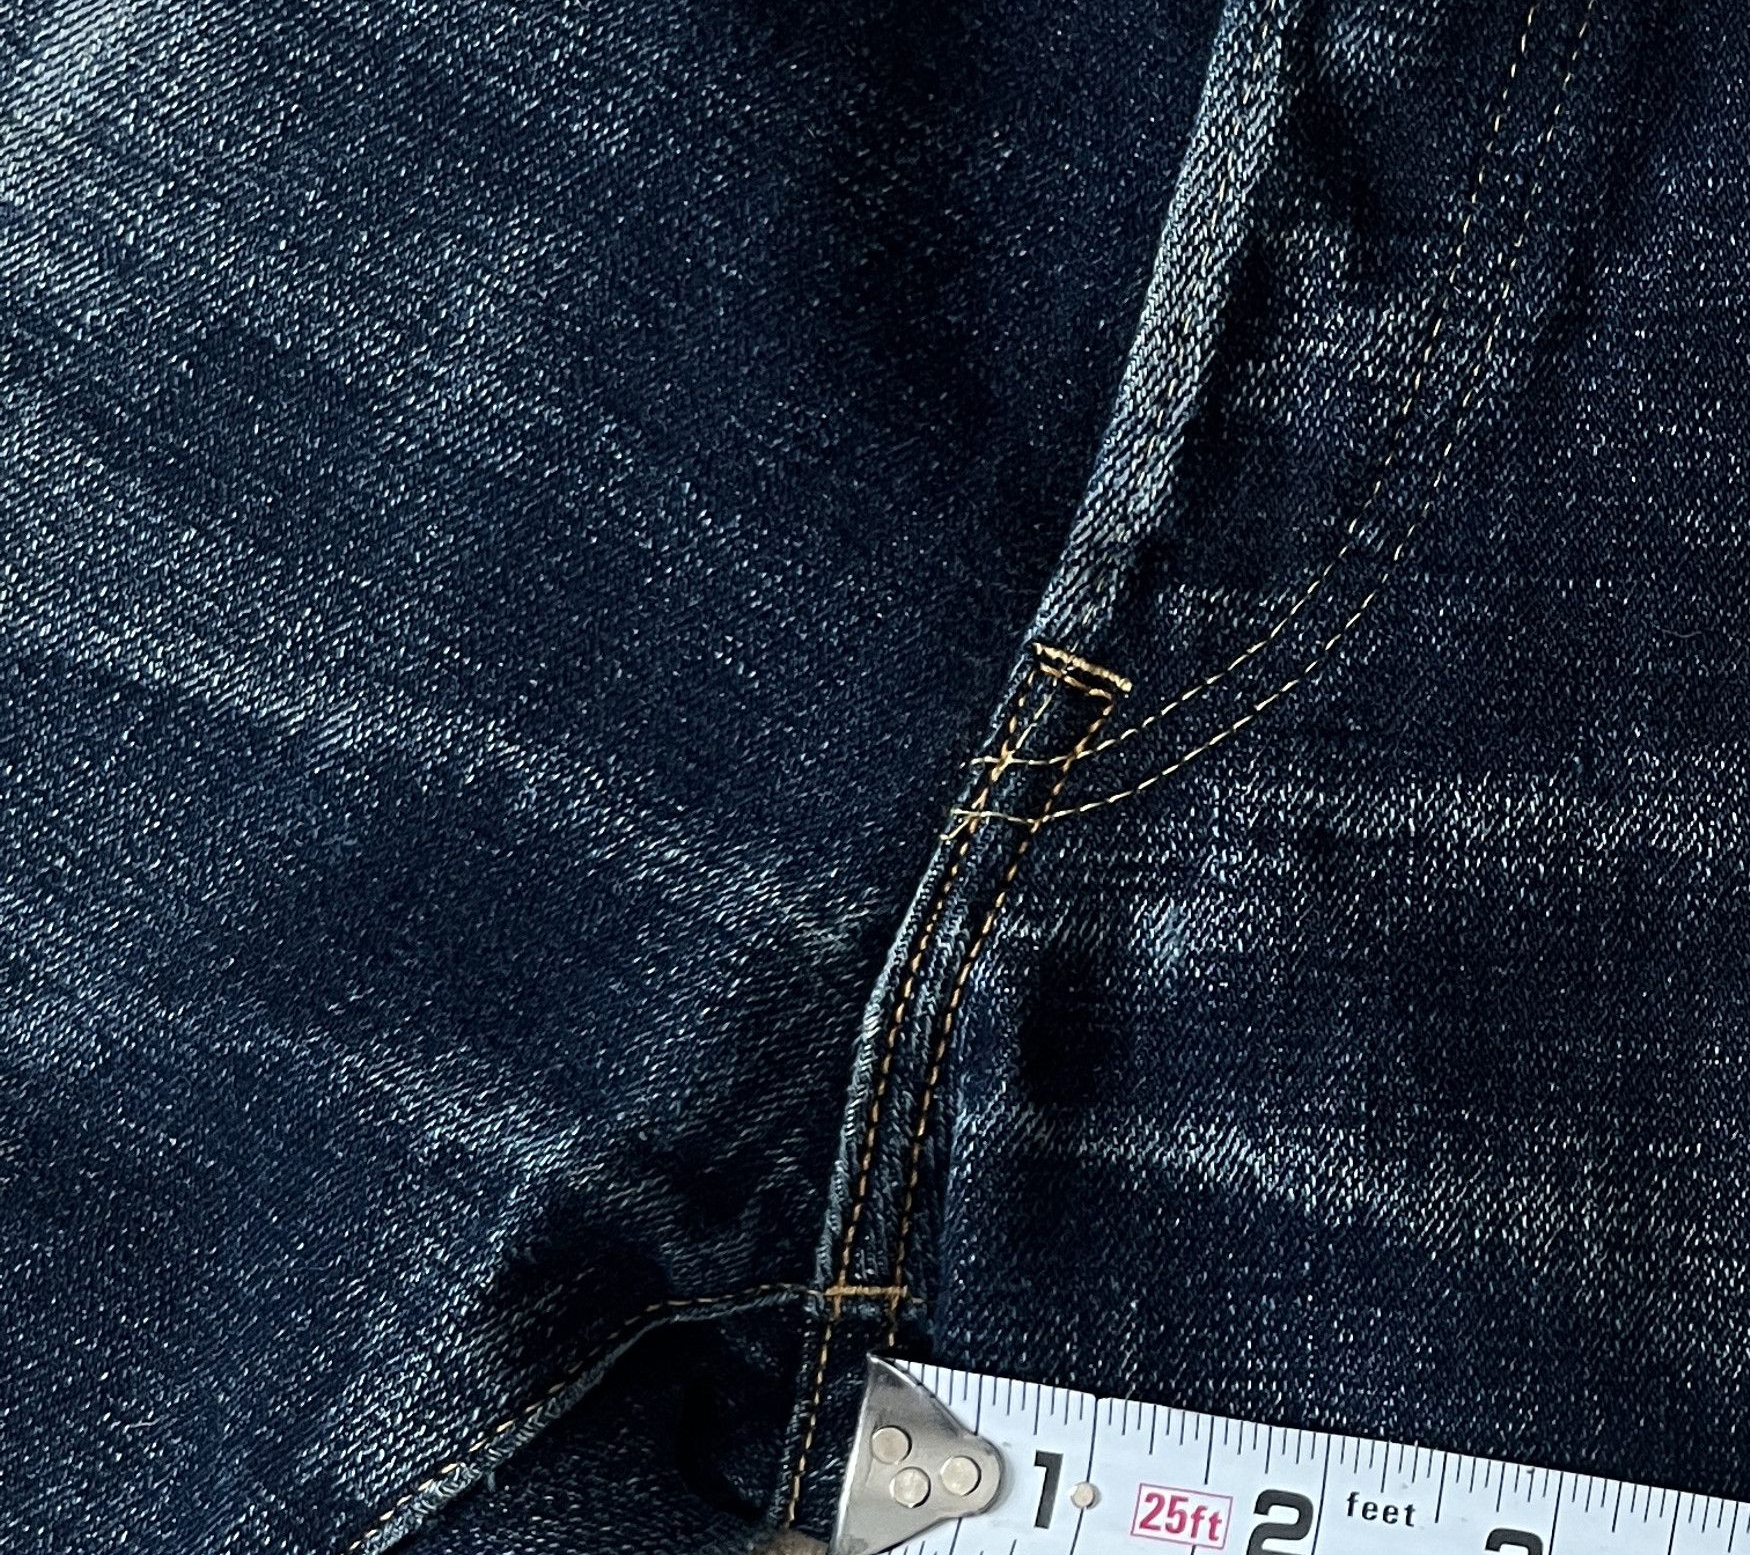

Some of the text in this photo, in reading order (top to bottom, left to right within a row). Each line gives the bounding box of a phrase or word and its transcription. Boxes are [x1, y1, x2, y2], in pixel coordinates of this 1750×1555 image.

[1033, 1450, 1063, 1529] 1
[1347, 1491, 1416, 1527] feet
[1139, 1491, 1222, 1543] 25ft
